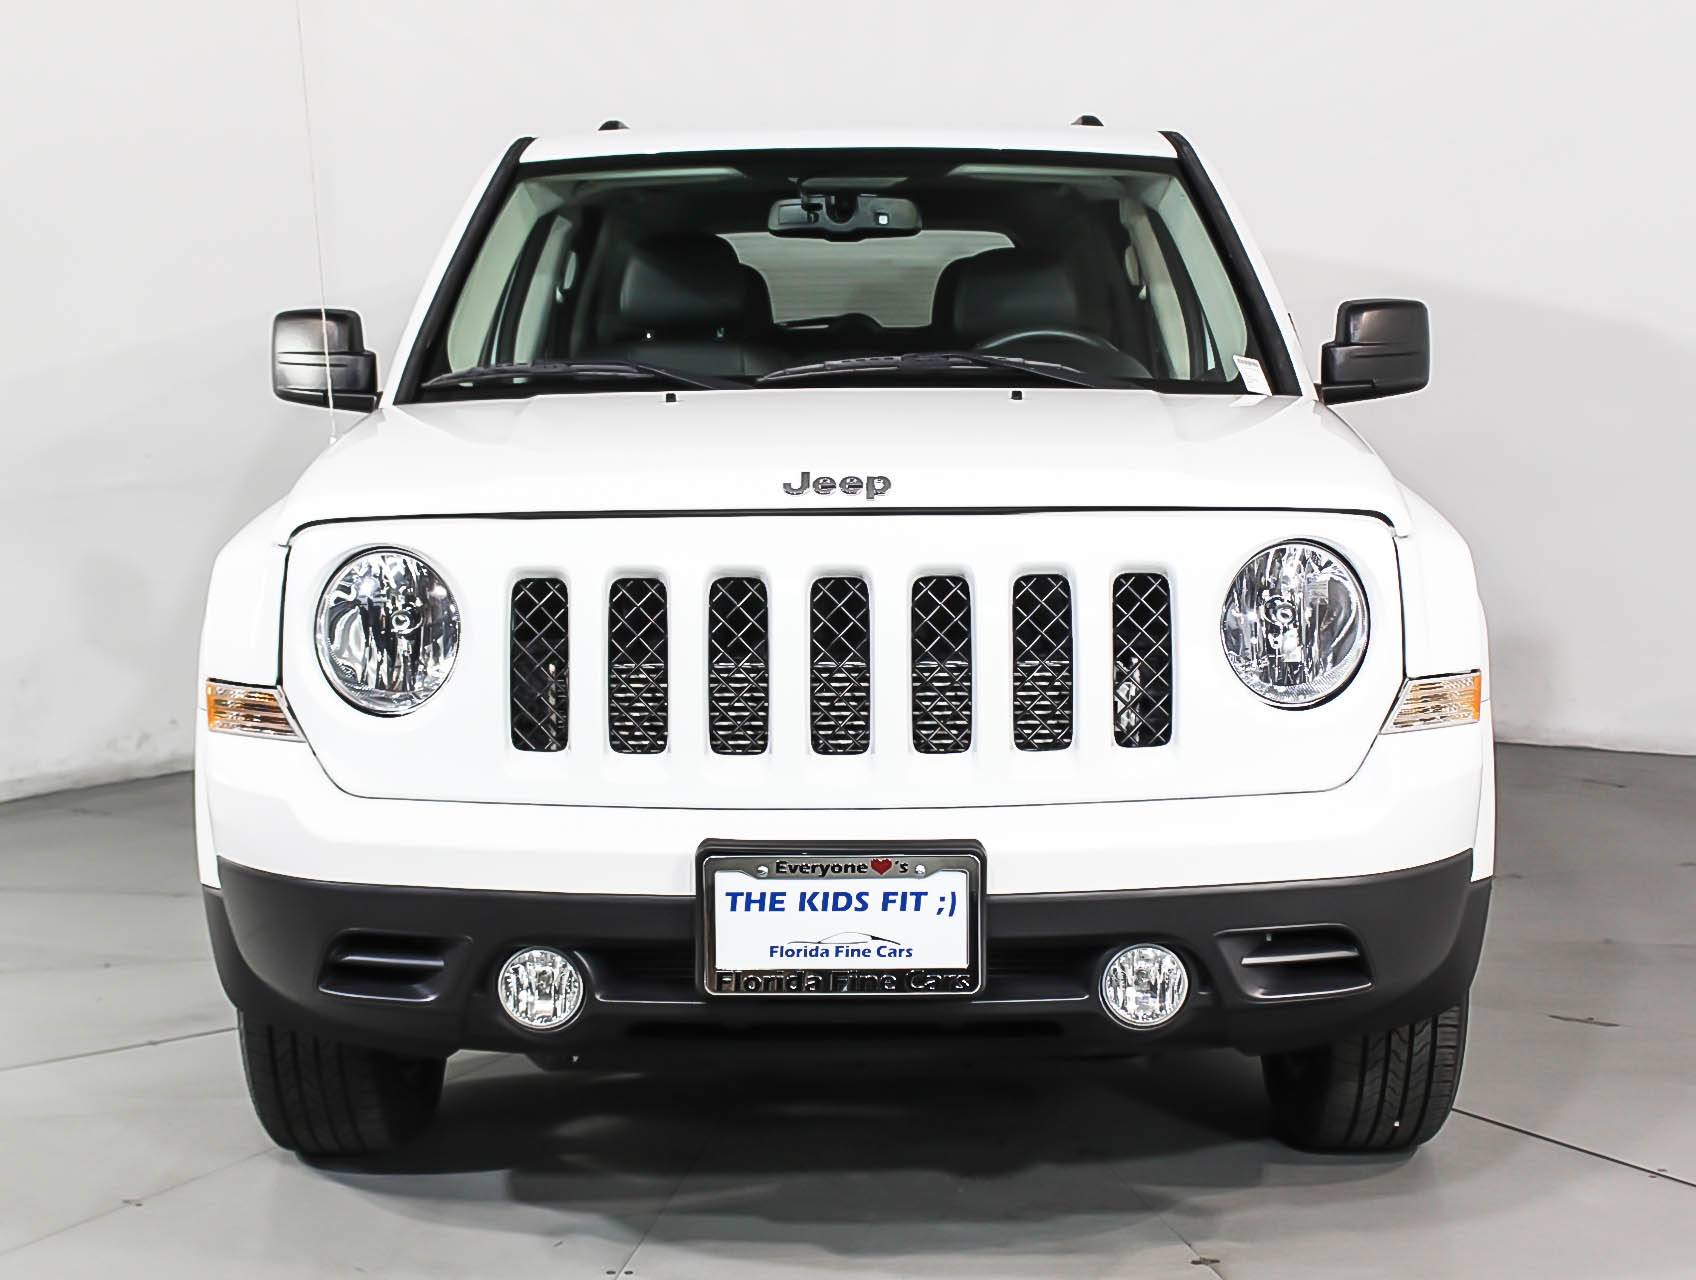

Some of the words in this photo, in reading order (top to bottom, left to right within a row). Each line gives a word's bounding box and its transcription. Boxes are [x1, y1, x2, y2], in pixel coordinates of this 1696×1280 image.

[783, 472, 891, 499] Jeep
[775, 860, 868, 877] Everyone
[725, 892, 787, 912] THE
[799, 892, 869, 912] KIDS
[881, 892, 928, 912] FIT
[769, 946, 830, 958] Florida
[835, 946, 871, 958] Fine
[876, 946, 913, 958] Cars
[716, 970, 823, 992] Florida
[904, 969, 970, 992] Cars
